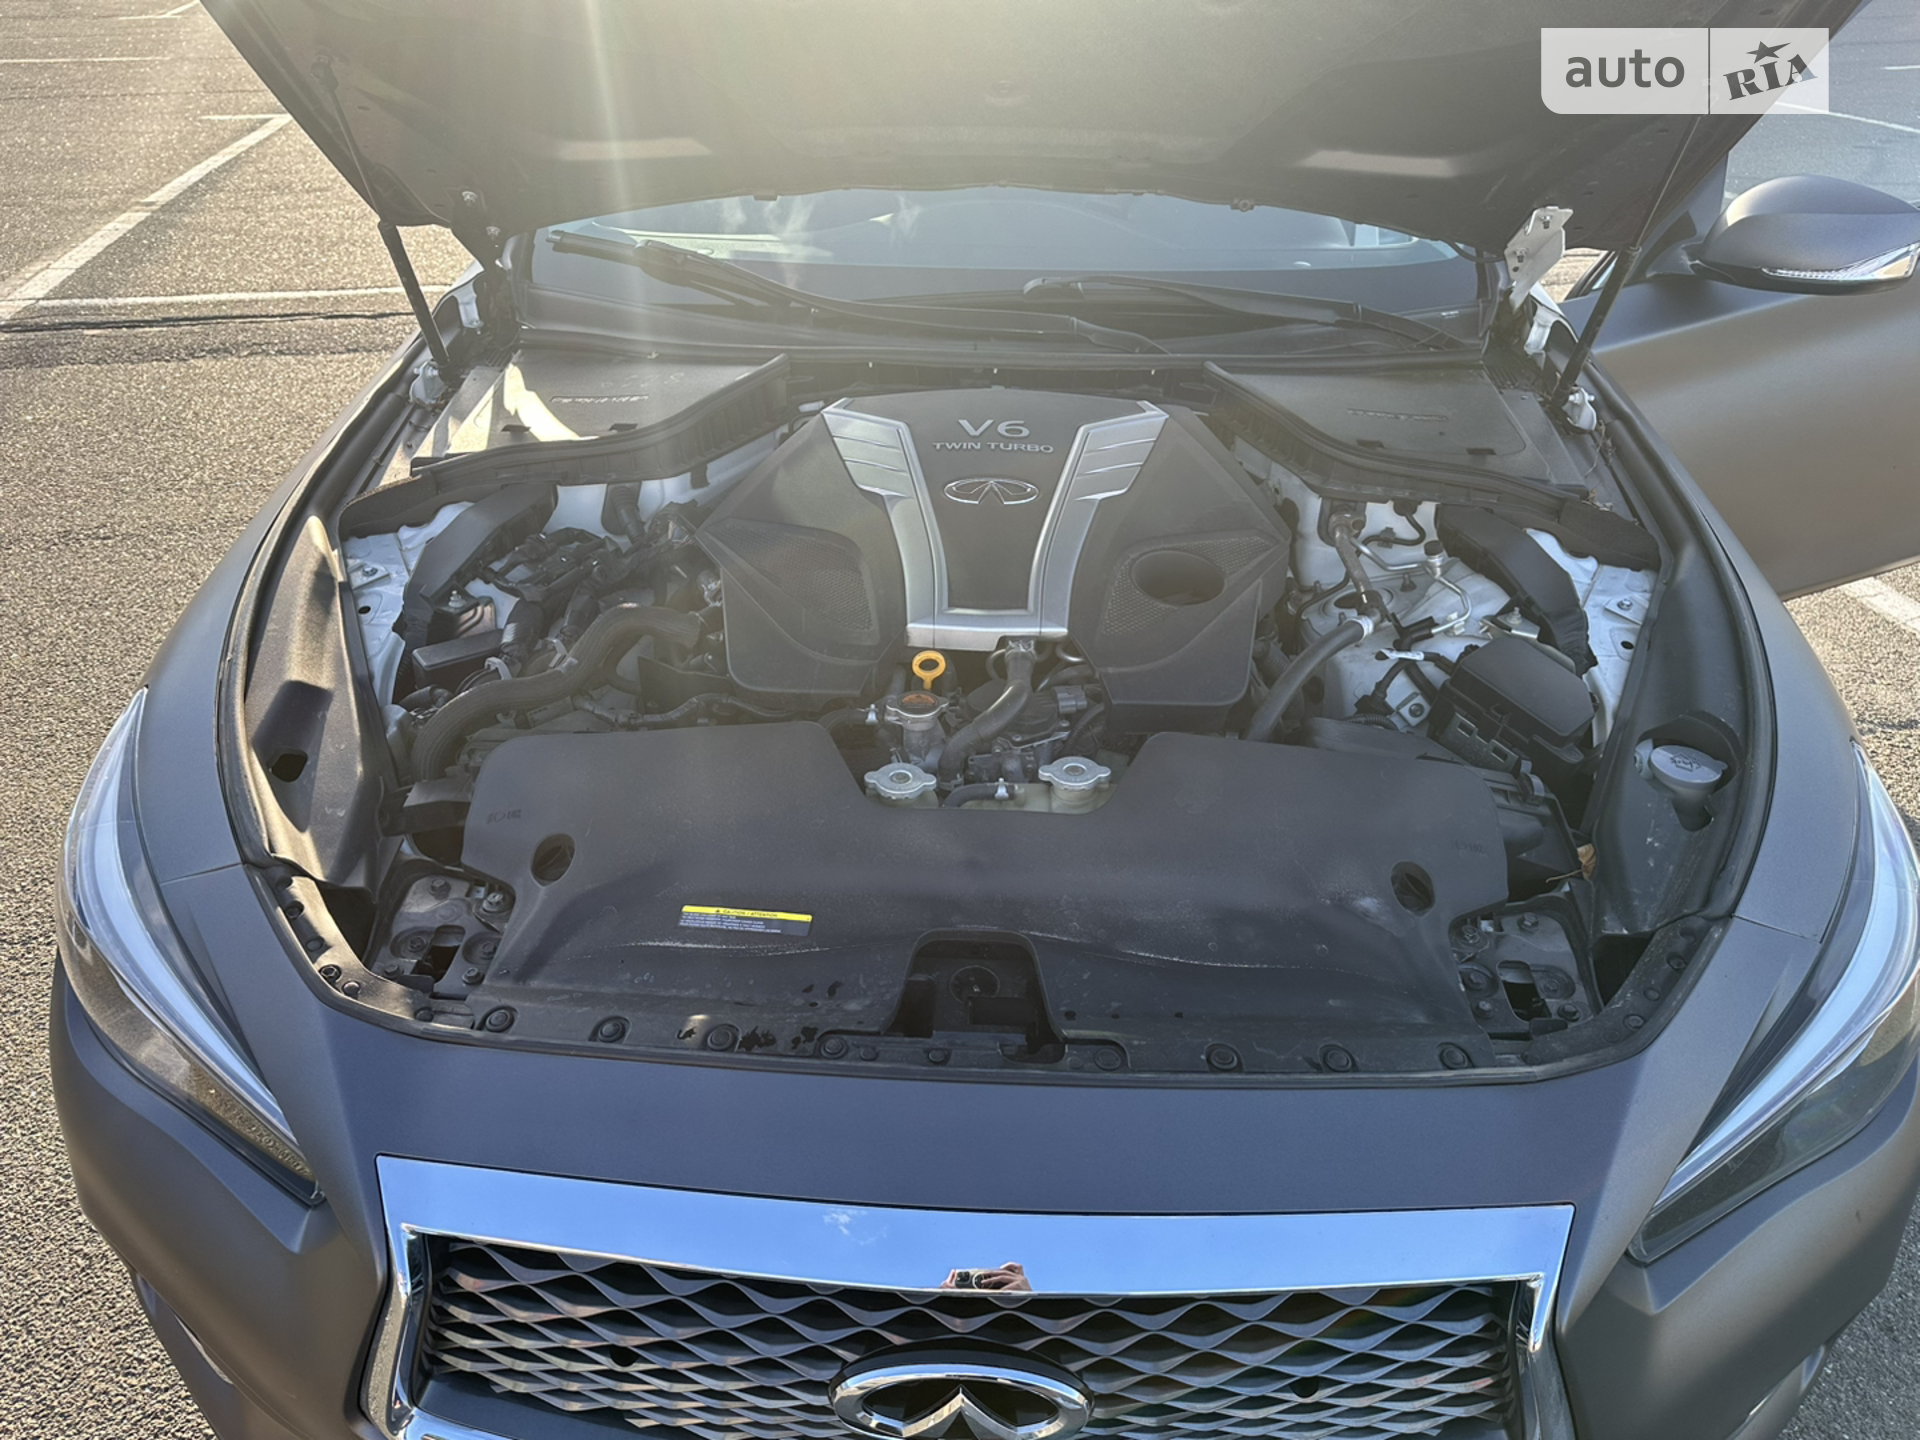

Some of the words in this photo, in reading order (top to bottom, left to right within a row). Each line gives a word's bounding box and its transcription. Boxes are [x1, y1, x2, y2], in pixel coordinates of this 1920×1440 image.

[957, 419, 1031, 438] V6
[932, 441, 981, 450] TWIN
[986, 442, 1054, 453] TURBO
